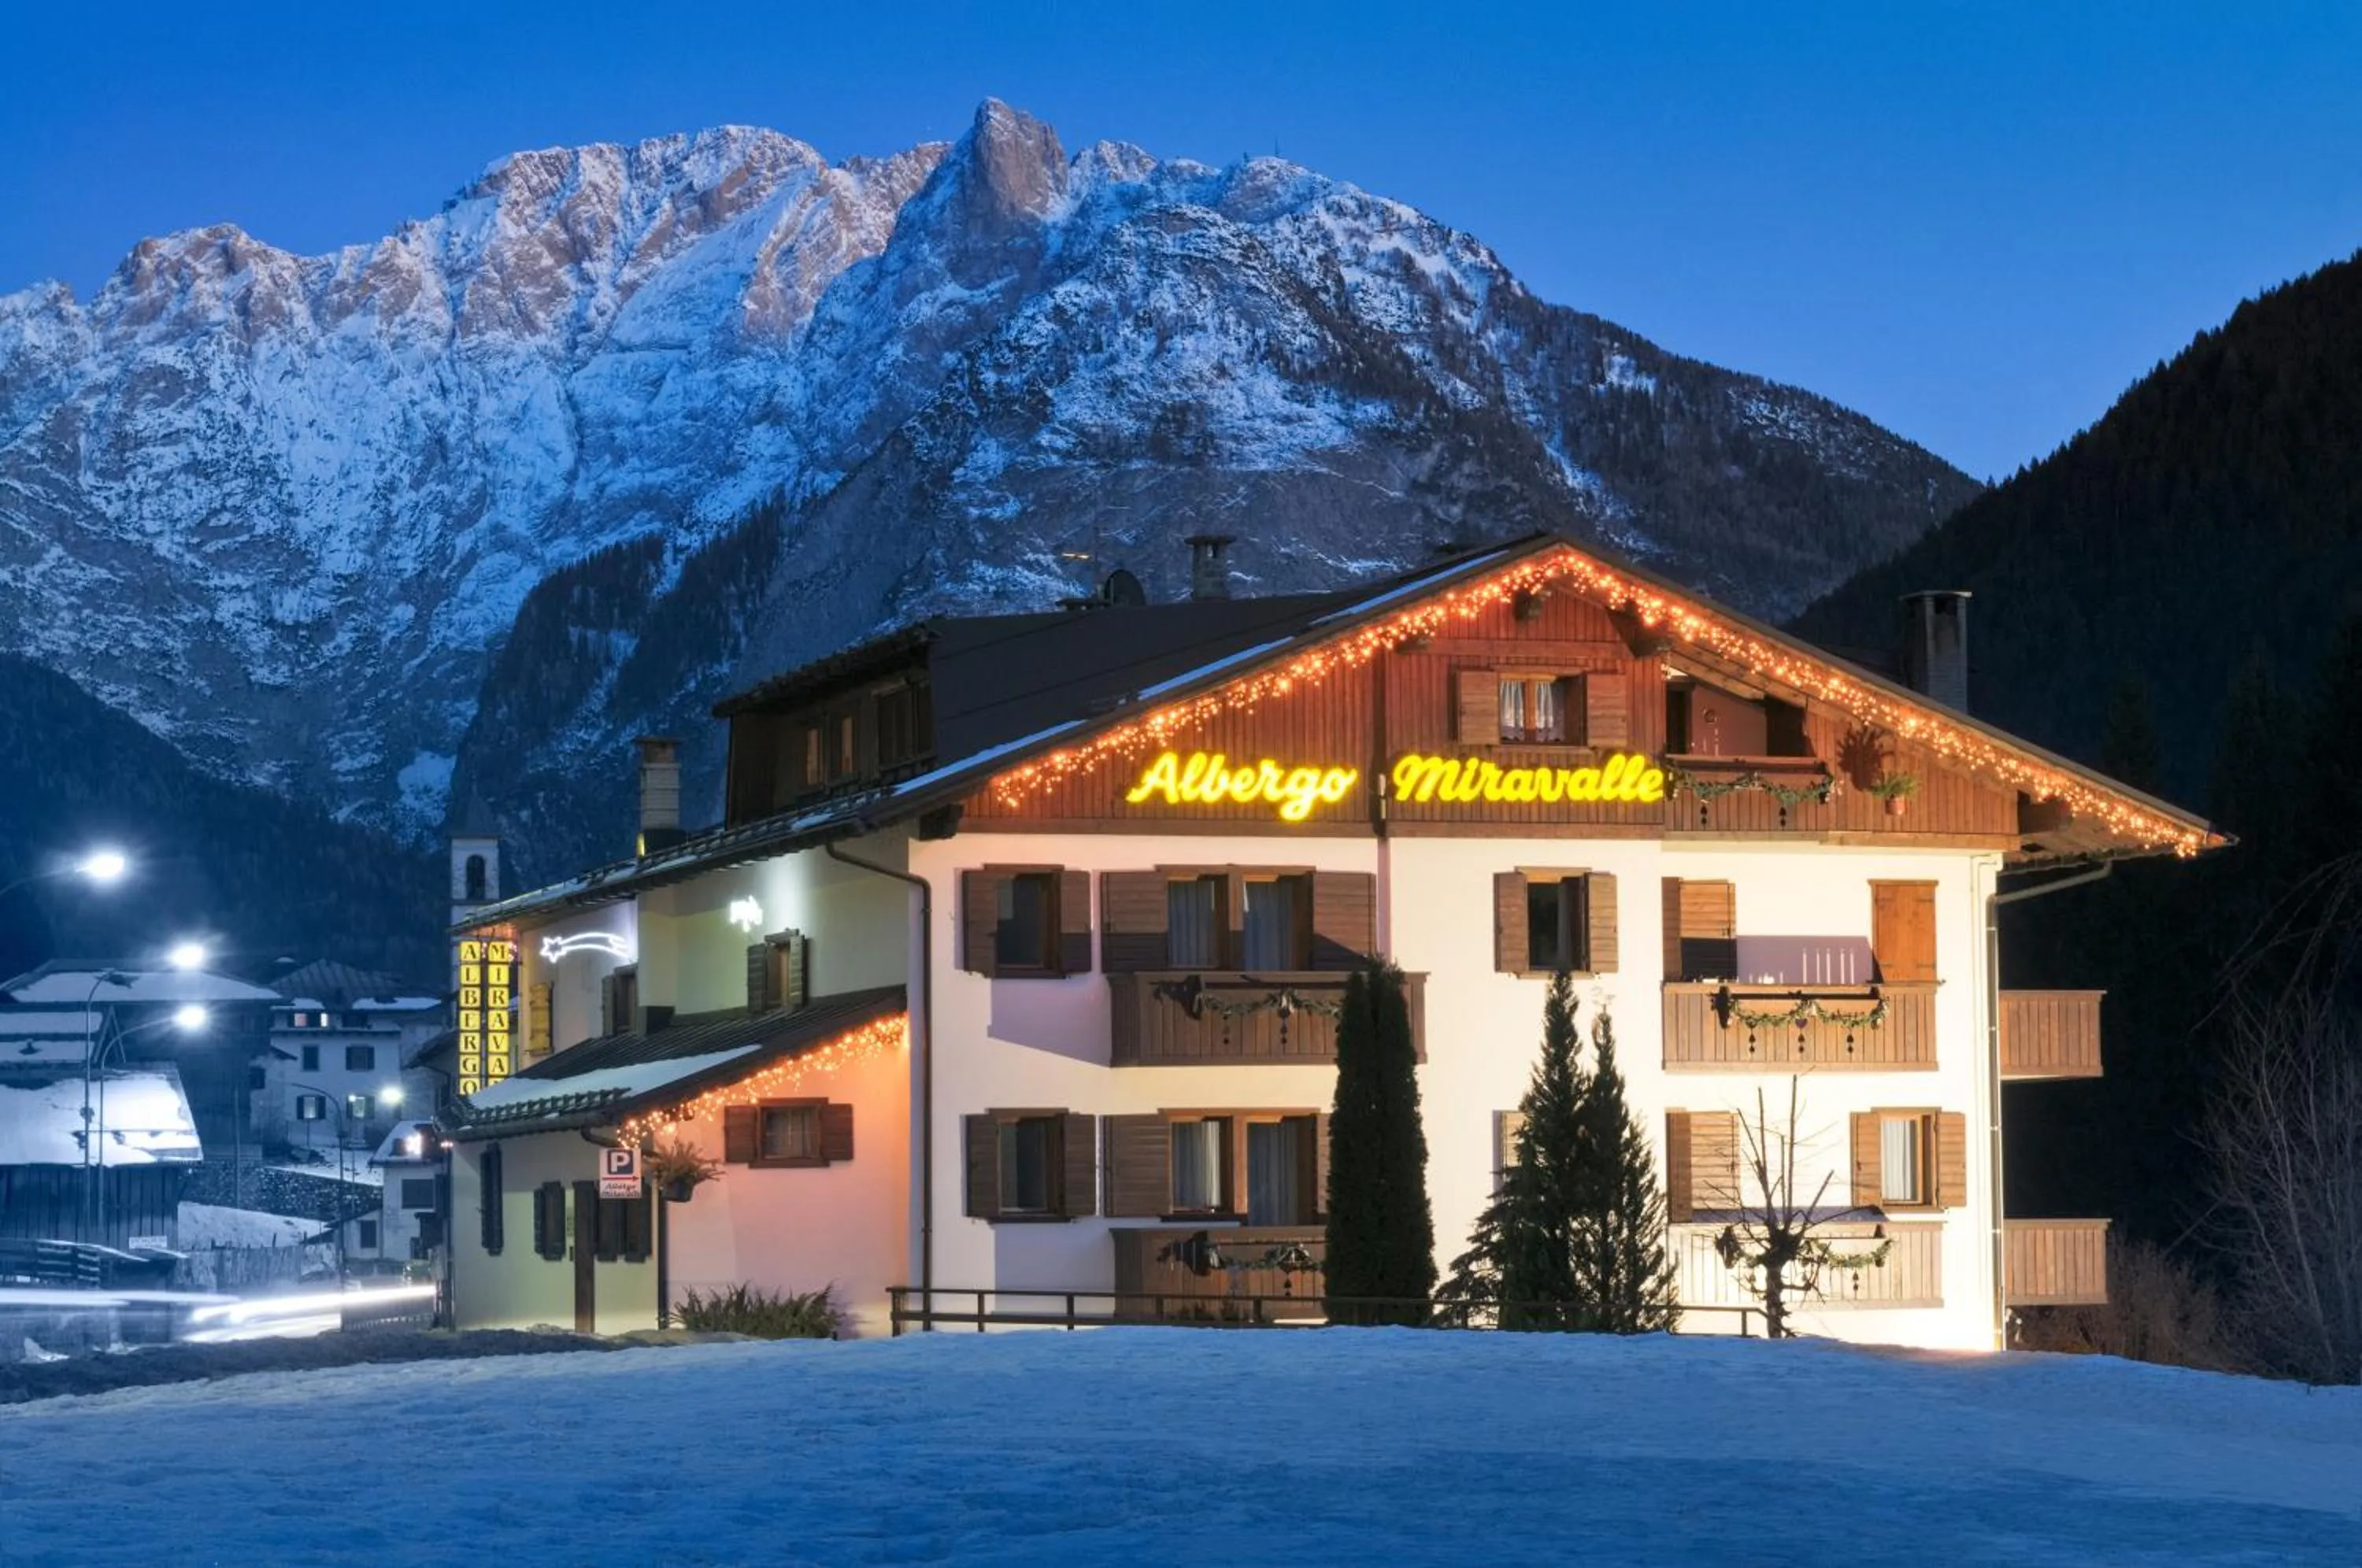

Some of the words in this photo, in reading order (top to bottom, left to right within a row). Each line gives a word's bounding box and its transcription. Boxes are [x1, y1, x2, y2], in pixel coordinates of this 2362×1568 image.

[1126, 752, 1358, 820] Albergo
[1393, 753, 1664, 802] Miravalle
[462, 944, 477, 1095] ALBERGO
[491, 944, 505, 1084] MIRAVA
[611, 1152, 630, 1172] P
